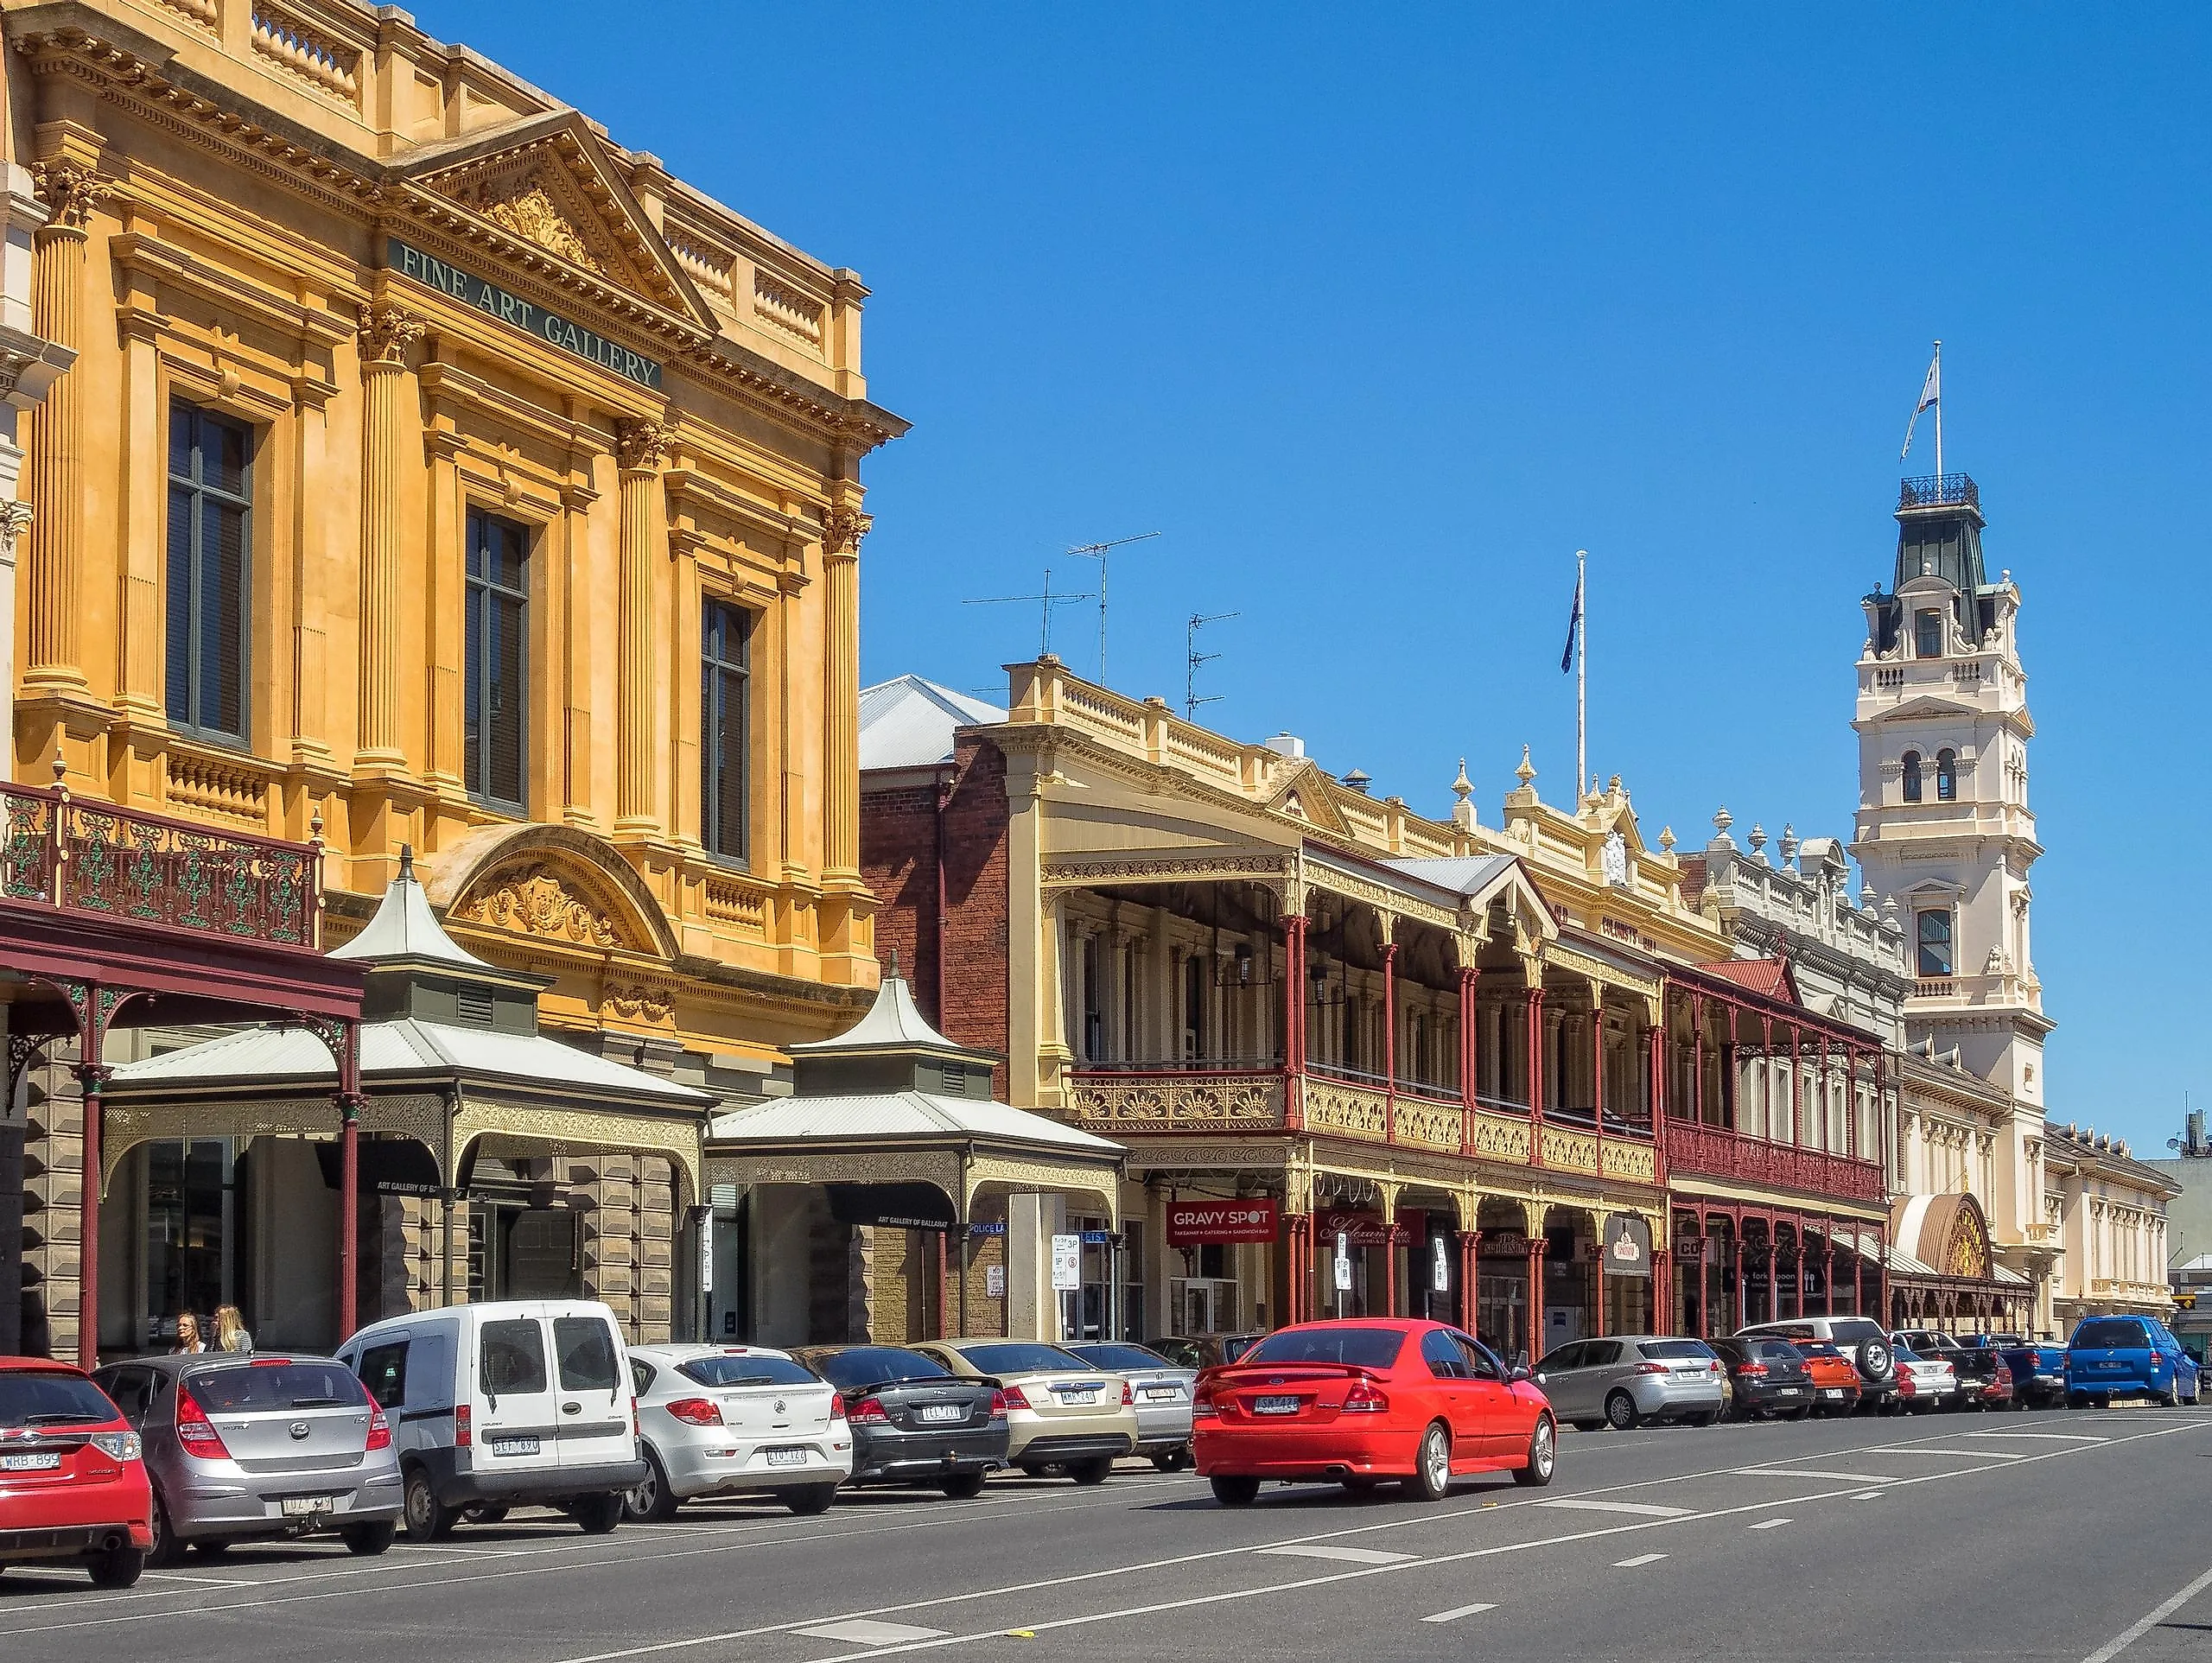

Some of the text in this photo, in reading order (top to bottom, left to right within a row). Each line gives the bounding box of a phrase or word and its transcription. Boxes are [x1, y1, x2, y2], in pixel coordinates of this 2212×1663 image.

[401, 244, 657, 387] FINE ART GALLERY
[391, 1182, 419, 1191] GALLERY
[889, 1216, 913, 1225] GALLERY
[921, 1219, 948, 1228] BALLARAT
[1173, 1210, 1269, 1225] GRAVY SPOT
[1320, 1214, 1411, 1238] Alexania
[1080, 1233, 1102, 1241] LETS
[1067, 1240, 1077, 1249] 3P
[1752, 1271, 1768, 1279] fork
[1776, 1272, 1796, 1280] poon
